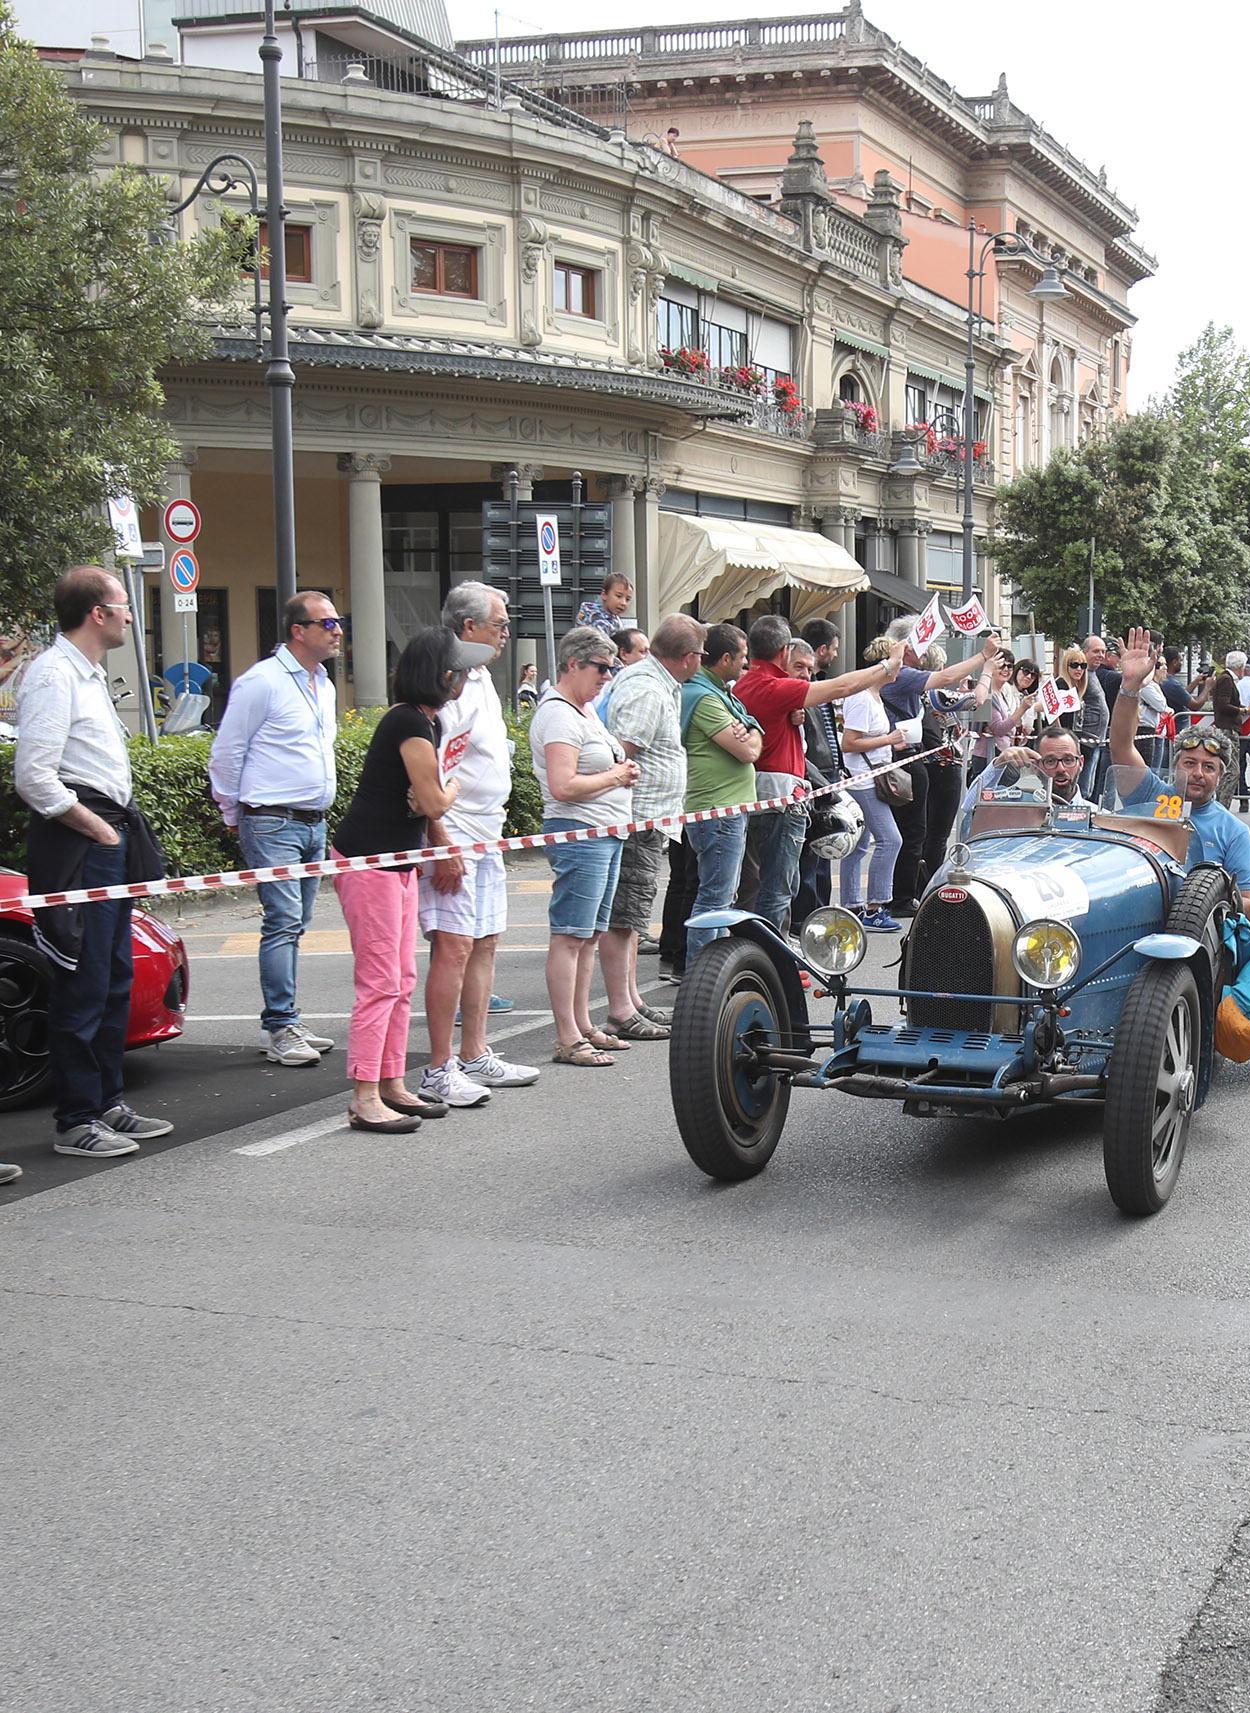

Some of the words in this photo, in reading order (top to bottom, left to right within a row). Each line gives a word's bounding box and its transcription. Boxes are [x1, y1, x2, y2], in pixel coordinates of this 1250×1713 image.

[1153, 794, 1182, 819] 28
[940, 891, 965, 899] BUGATTI
[1019, 871, 1065, 902] 28
